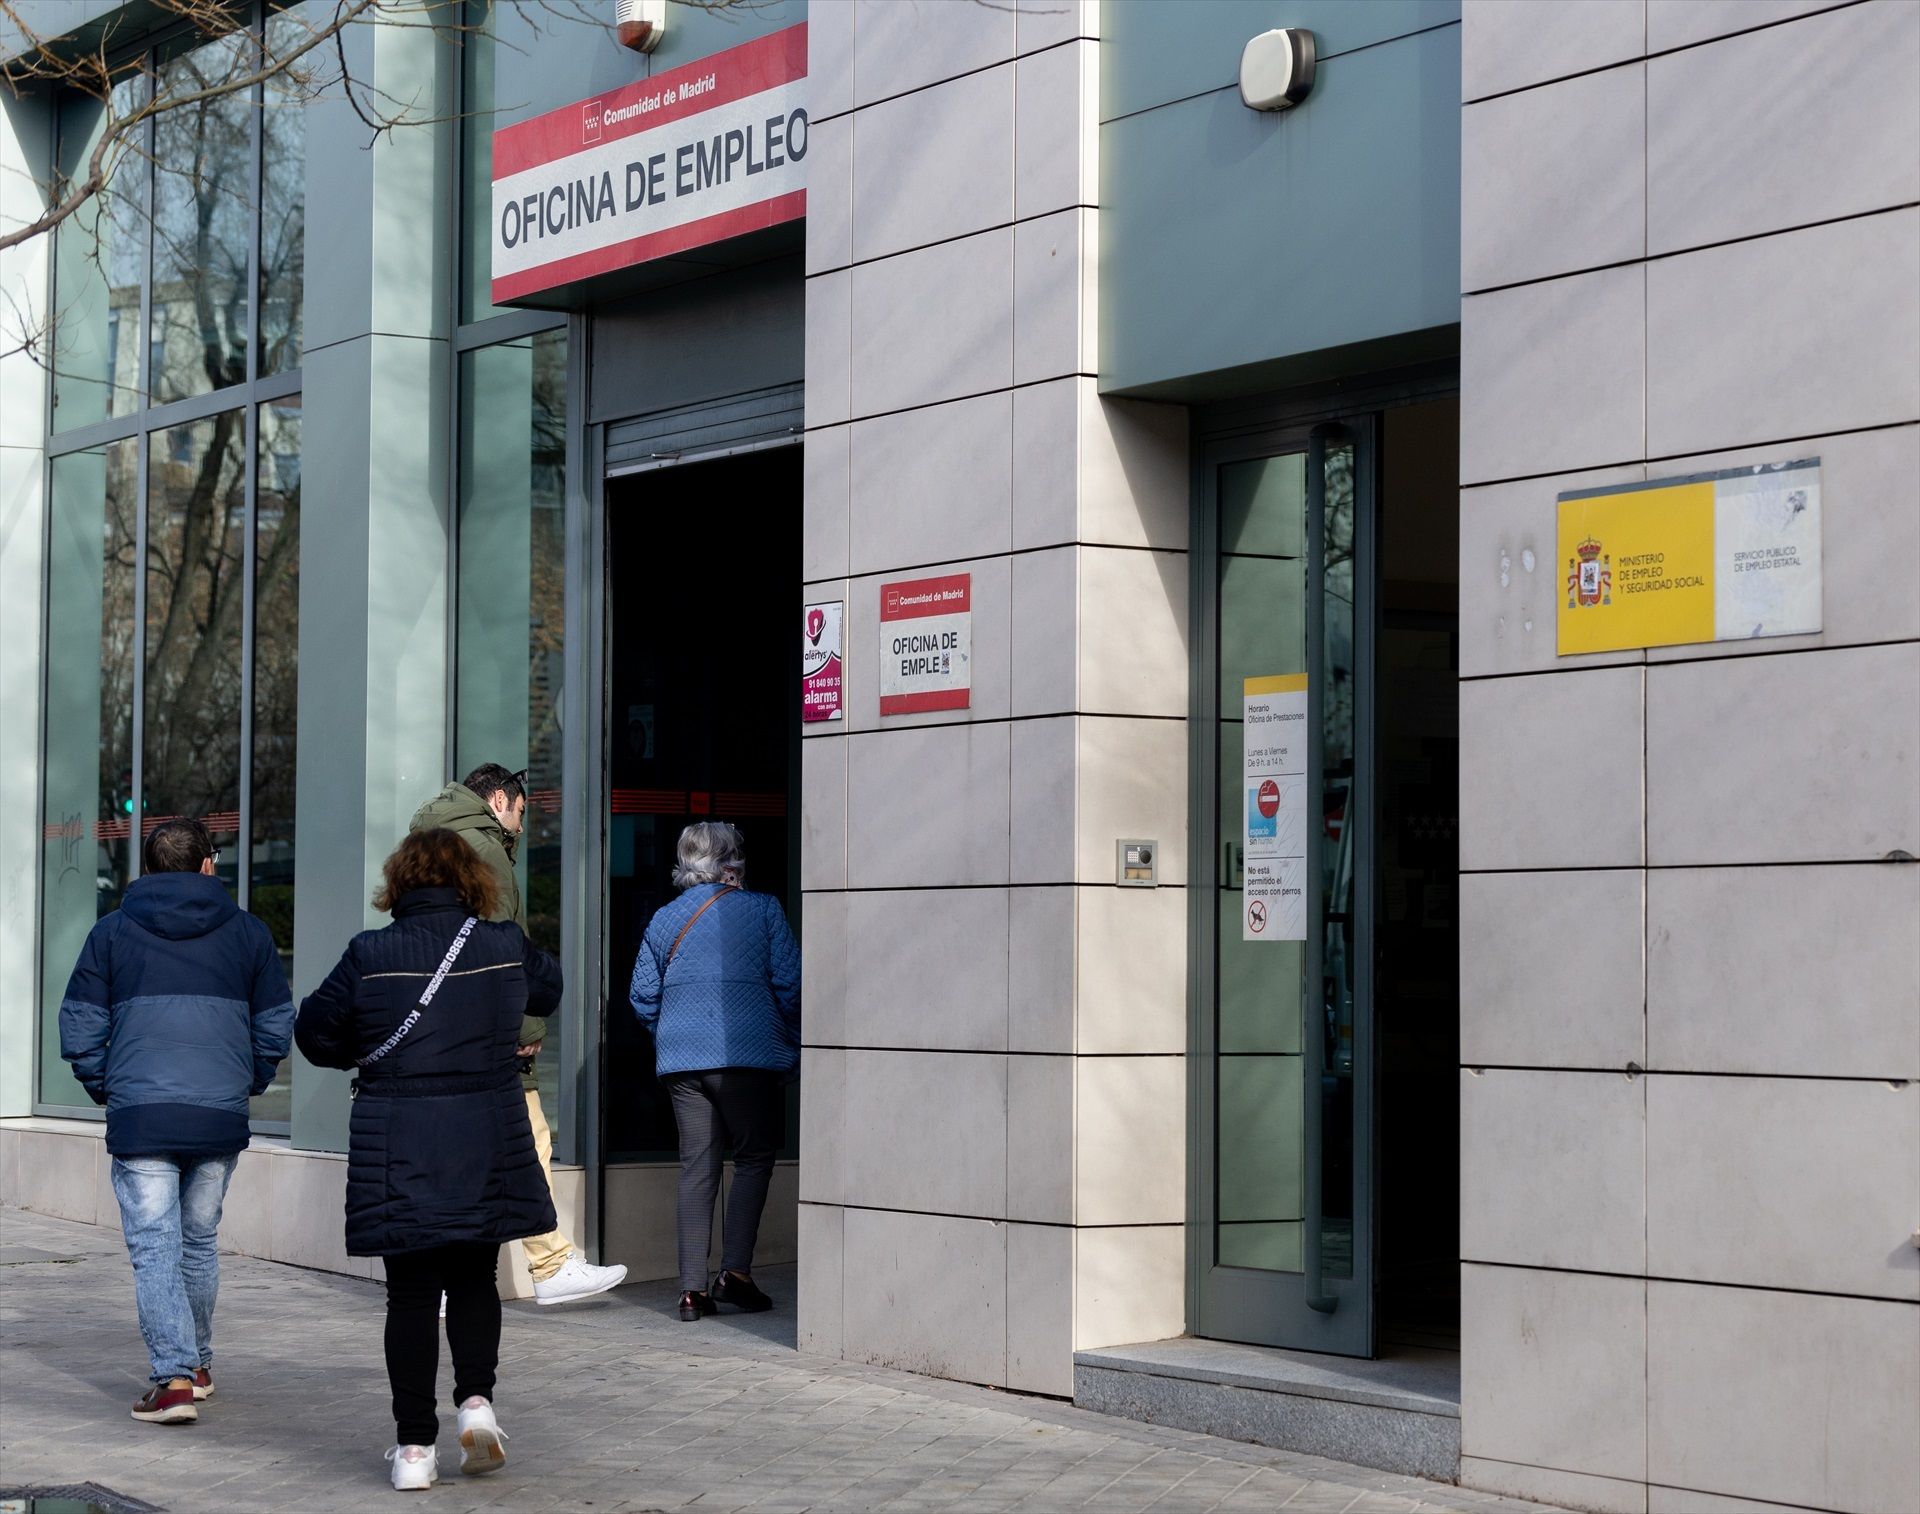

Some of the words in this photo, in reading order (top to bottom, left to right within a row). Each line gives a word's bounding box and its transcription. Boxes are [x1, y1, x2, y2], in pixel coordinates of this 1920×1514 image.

[603, 91, 661, 126] Comunidad
[663, 89, 676, 105] de
[679, 73, 716, 101] Madrid
[501, 170, 616, 249] OFICINA
[625, 152, 666, 213] DE
[676, 107, 808, 198] EMPLEO
[1619, 552, 1664, 567] MINISTERIO
[1734, 550, 1764, 561] SERVICIO
[1734, 563, 1744, 572] DE
[1745, 560, 1772, 571] EMPLEO
[1774, 557, 1801, 568] ESTATAL
[1619, 570, 1630, 581] DE
[1632, 566, 1663, 579] EMPLEO
[1619, 584, 1625, 594] Y
[1627, 578, 1672, 593] SEGURIDAD
[1675, 576, 1704, 588] SOCIAL
[900, 593, 932, 605] Comunidad
[934, 592, 941, 601] de
[942, 589, 964, 600] Madrid
[892, 634, 939, 655] OFICINA
[941, 632, 958, 650] DE
[901, 656, 940, 676] EMPLE
[809, 679, 816, 688] 91
[816, 679, 826, 688] 840
[827, 678, 833, 687] 90
[834, 677, 841, 686] 35
[804, 690, 838, 704] alarma
[1248, 704, 1269, 713] Horario
[1248, 715, 1265, 723] Oficina
[1273, 713, 1304, 722] Prestaciones
[1248, 748, 1263, 757] Lunes
[1268, 747, 1287, 755] Viernes
[1248, 759, 1255, 767] De
[1248, 867, 1256, 875] No
[1257, 866, 1270, 875] está
[1248, 877, 1275, 886] permitido
